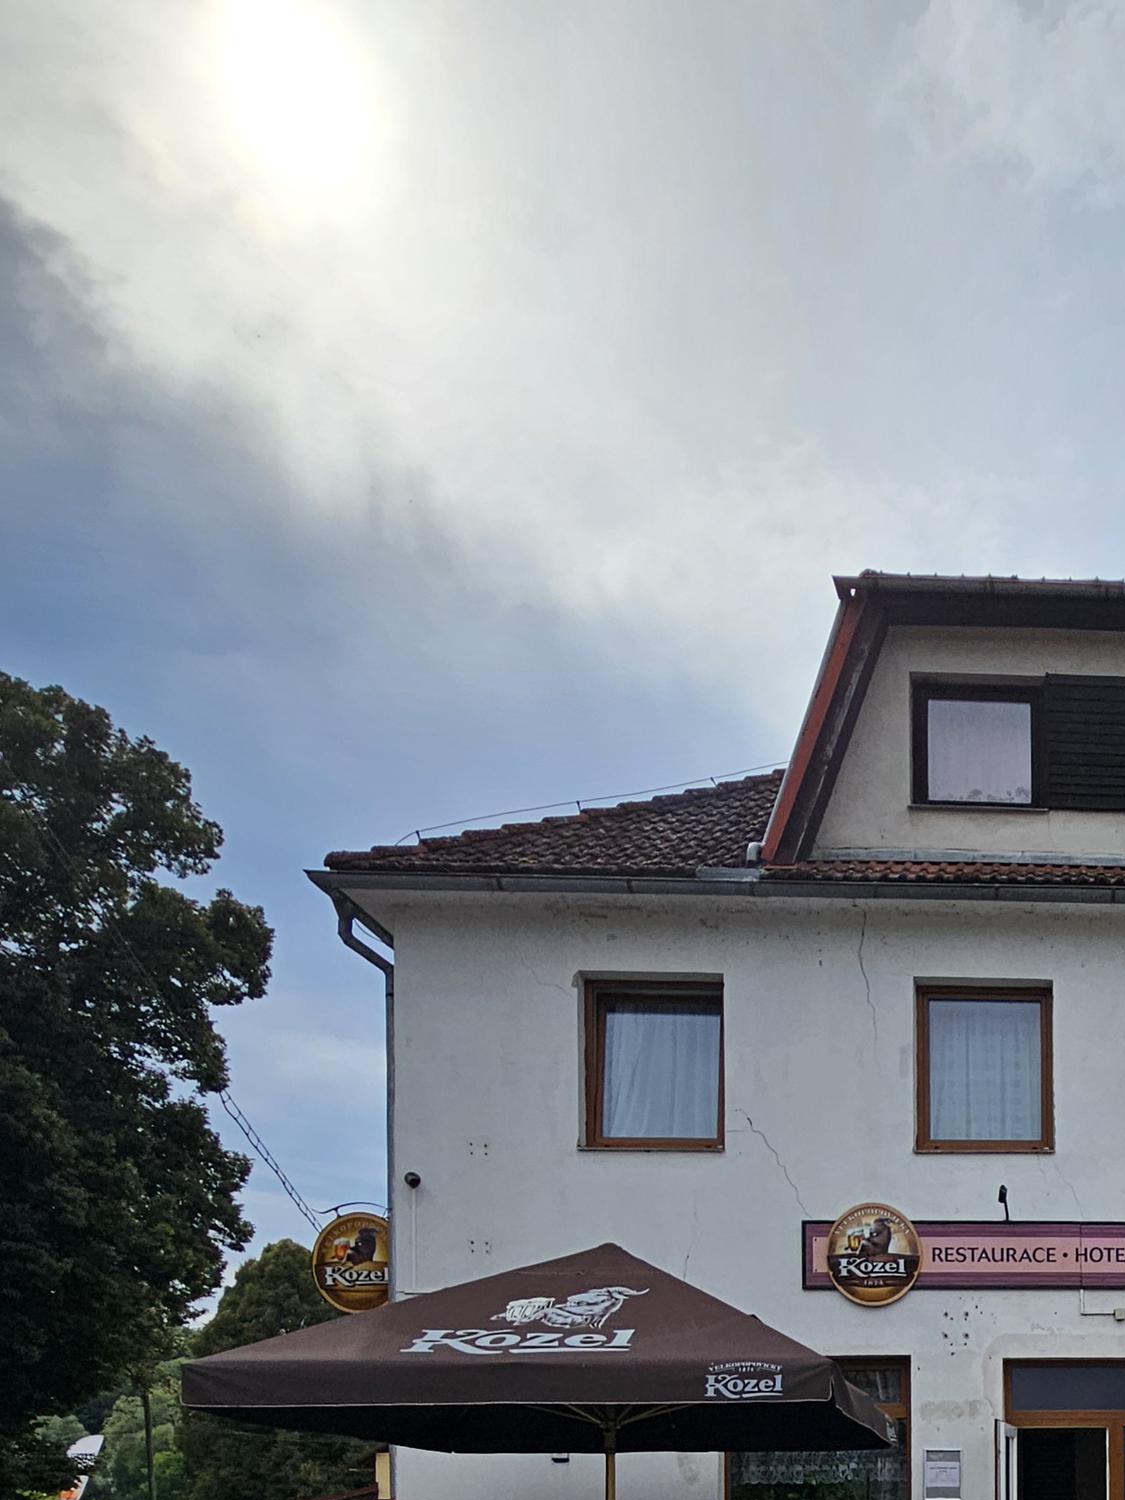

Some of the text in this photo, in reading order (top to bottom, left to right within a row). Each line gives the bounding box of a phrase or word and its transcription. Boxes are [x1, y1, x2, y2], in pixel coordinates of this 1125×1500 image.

[932, 1247, 1057, 1263] RESTAURACE
[325, 1265, 389, 1287] Kozel
[838, 1257, 907, 1278] Kozel
[399, 1329, 635, 1355] Kozel
[704, 1374, 784, 1399] Kozel
